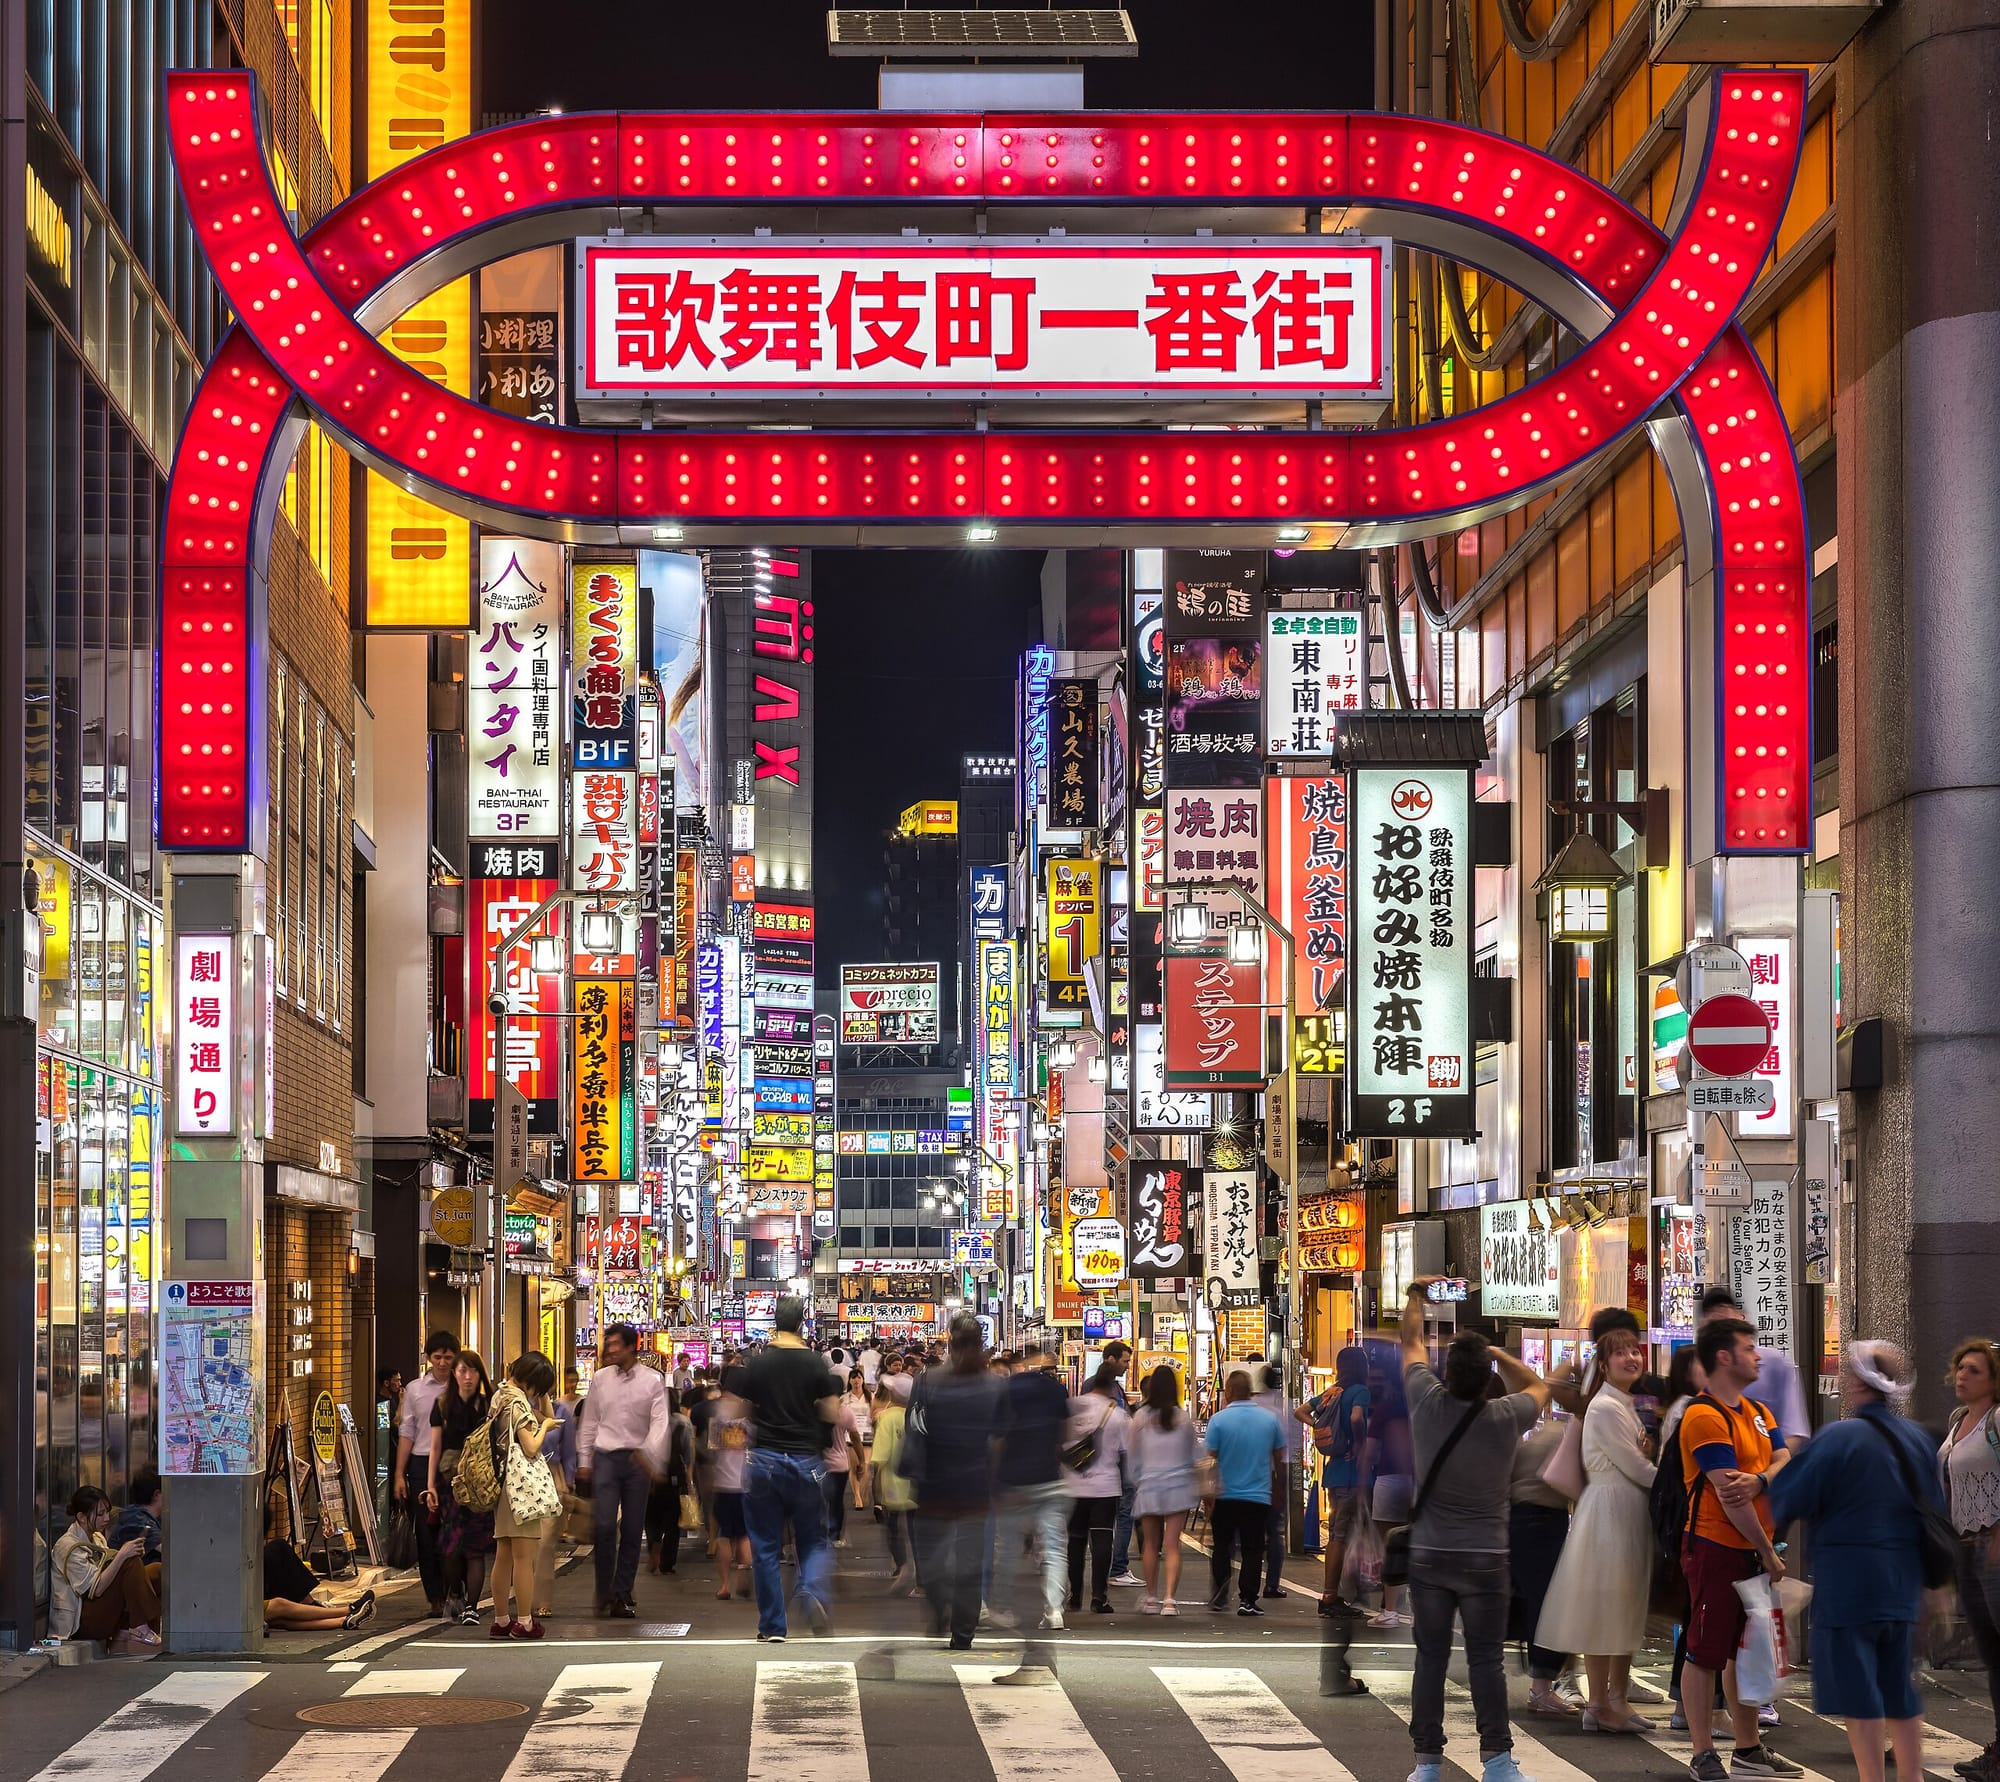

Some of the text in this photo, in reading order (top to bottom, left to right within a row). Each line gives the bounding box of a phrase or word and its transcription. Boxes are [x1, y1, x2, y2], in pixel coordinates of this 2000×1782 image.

[615, 269, 1354, 372] 歌舞伎町一番街
[480, 318, 555, 351] 小料理
[1244, 570, 1256, 578] 3F
[483, 595, 545, 611] RESTAURANT
[490, 592, 537, 603] BAN-THAI
[1139, 601, 1155, 613] 4F
[1177, 587, 1254, 617] 鶏の庭
[1272, 616, 1359, 635] 全卓全自動
[585, 573, 625, 730] まぐろ商店
[1173, 645, 1186, 653] 2F
[479, 621, 525, 778] バンタイ
[531, 623, 550, 767] タイ国料理専門店
[1291, 639, 1322, 752] 東南荘
[578, 739, 630, 762] B1F
[1170, 734, 1257, 753] 酒場牧場
[1271, 740, 1287, 753] 3F
[1061, 710, 1086, 813] 山久農場
[486, 789, 543, 798] BAN-THAI
[478, 799, 550, 809] RESTAURANT
[496, 813, 531, 832] 3F
[1065, 818, 1083, 826] 5F
[1174, 797, 1259, 839] 焼肉
[484, 848, 545, 876] 焼肉
[1174, 850, 1259, 870] 韓国料理
[1056, 880, 1093, 897] 麻雀
[1429, 828, 1454, 948] 歌舞伎町名物
[1057, 902, 1093, 912] ナンバー
[754, 911, 811, 931] 全店営業中
[1056, 917, 1084, 976] 1
[1372, 822, 1424, 1076] お好み焼本陣
[589, 959, 620, 974] 4F
[745, 953, 754, 991] カラオケ
[845, 968, 936, 981] コミック&ネットカフェ
[700, 948, 719, 1045] カラオケ 47
[755, 982, 812, 994] FACE
[866, 985, 931, 1008] aprecio
[1058, 985, 1089, 1003] 4F
[622, 986, 634, 1034] 炭火串焼
[987, 948, 1009, 1085] まんが喫茶
[1194, 961, 1238, 1068] ステップ
[189, 951, 221, 1117] 劇場通り
[1304, 1018, 1331, 1042] 1
[769, 1063, 790, 1073] ゴルフ
[1301, 1049, 1344, 1072] 2F
[708, 1065, 721, 1104] 麻雀
[1208, 1073, 1224, 1082] B1
[1693, 1087, 1767, 1105] 自転車を除く
[1140, 1090, 1152, 1126] 一番街
[1387, 1098, 1433, 1124] 2F
[754, 1114, 810, 1137] まんが喫茶
[1185, 1114, 1209, 1125] B1F
[1272, 1094, 1283, 1158] 劇場通り一番街
[510, 1104, 521, 1168] 劇場通り一番街
[841, 1134, 863, 1151] つり具
[893, 1133, 916, 1151] 釣具
[927, 1132, 960, 1142] TAX FR
[921, 1144, 940, 1153] 免税
[751, 1157, 789, 1175] ゲーム
[755, 1189, 808, 1201] メンズサウナ
[1163, 1170, 1182, 1242] 東京豚骨
[1222, 1181, 1255, 1278] お好み焼き
[1732, 1217, 1742, 1256] Security
[958, 1237, 982, 1247] 完全
[1210, 1225, 1219, 1271] TEPPANYAKI
[969, 1248, 992, 1259] 個室
[1085, 1253, 1120, 1269] 190円
[1743, 1245, 1753, 1276] Safety
[853, 1261, 891, 1271] コーヒー
[920, 1260, 940, 1272] クール
[1754, 1199, 1774, 1348] 防犯カメラ作動中
[1735, 1260, 1743, 1297] Camera
[1233, 1294, 1258, 1305] B1F
[848, 1304, 917, 1317] 無料案内所
[316, 1410, 334, 1427] Public
[316, 1428, 334, 1444] Stand
